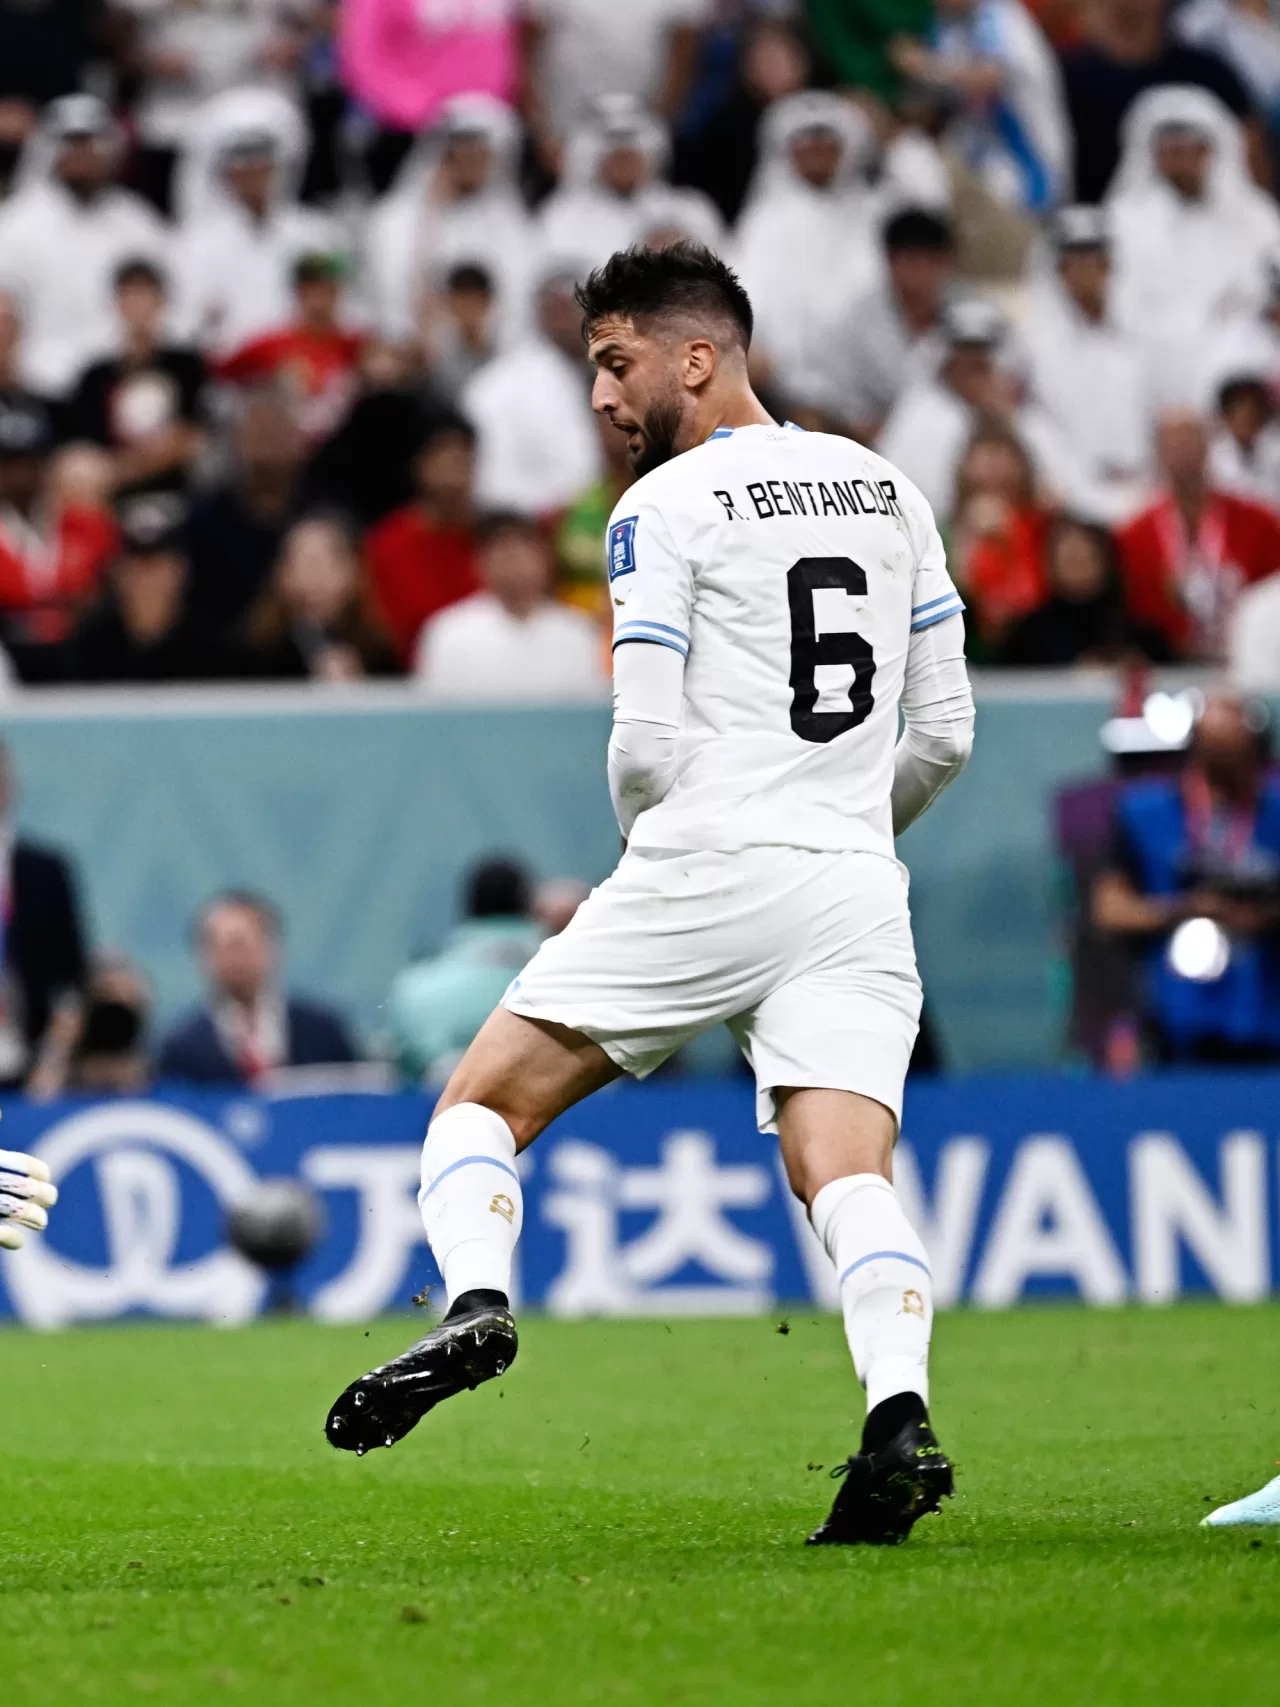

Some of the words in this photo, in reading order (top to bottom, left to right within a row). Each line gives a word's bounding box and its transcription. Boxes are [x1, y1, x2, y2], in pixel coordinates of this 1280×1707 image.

[712, 490, 750, 521] R.
[746, 479, 903, 520] BENTANCUR
[786, 556, 875, 743] 6
[775, 1131, 1280, 1310] WAN
